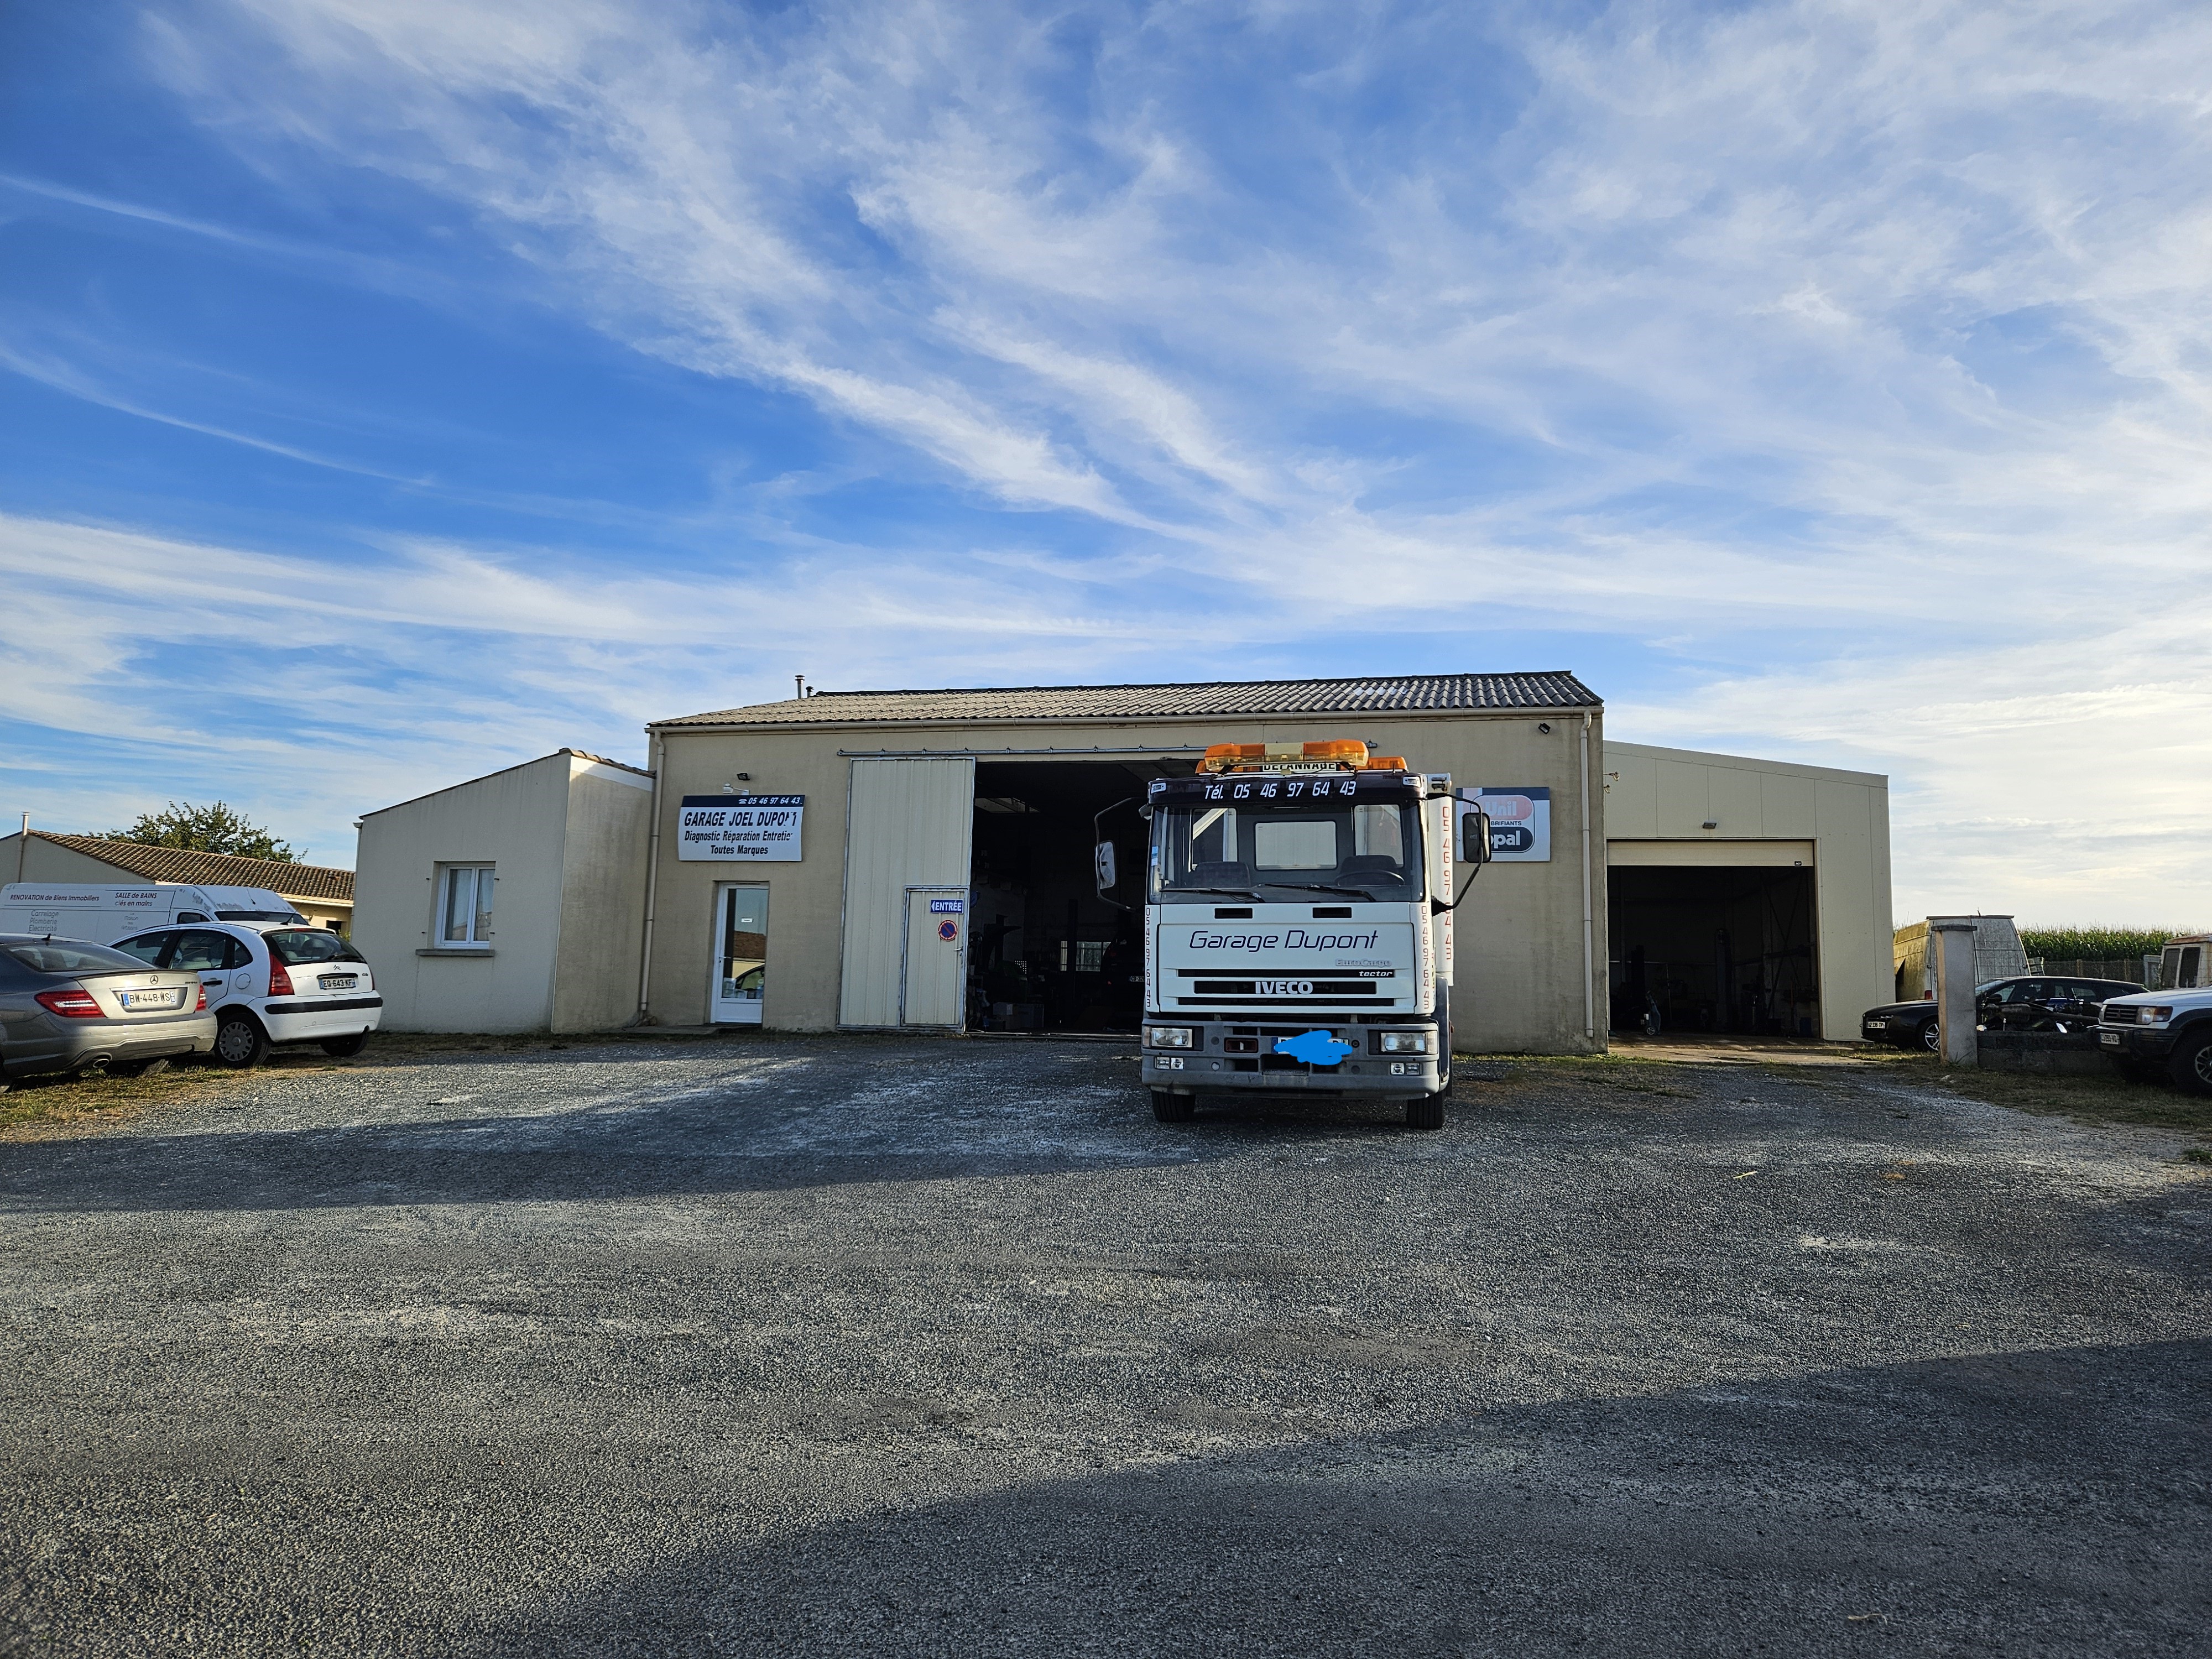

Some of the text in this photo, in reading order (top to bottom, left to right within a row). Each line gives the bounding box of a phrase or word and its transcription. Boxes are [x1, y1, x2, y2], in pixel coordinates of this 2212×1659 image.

[1204, 780, 1356, 799] Tél. 05 46 97 64 43
[1485, 801, 1517, 816] Unil
[684, 812, 727, 826] GARAGE
[729, 812, 754, 826] JOEL
[684, 830, 793, 843] Diagnostic Réparation Entretie
[1490, 830, 1521, 849] pal
[711, 845, 768, 856] Toutes Marques
[935, 900, 962, 911] ENTRÉE
[31, 910, 59, 918] Carrelage
[1189, 930, 1378, 953] Garage Dupont
[1335, 958, 1391, 968] EuroCargo
[1255, 981, 1313, 994] IVECO
[129, 991, 170, 1004] BW-448-WS
